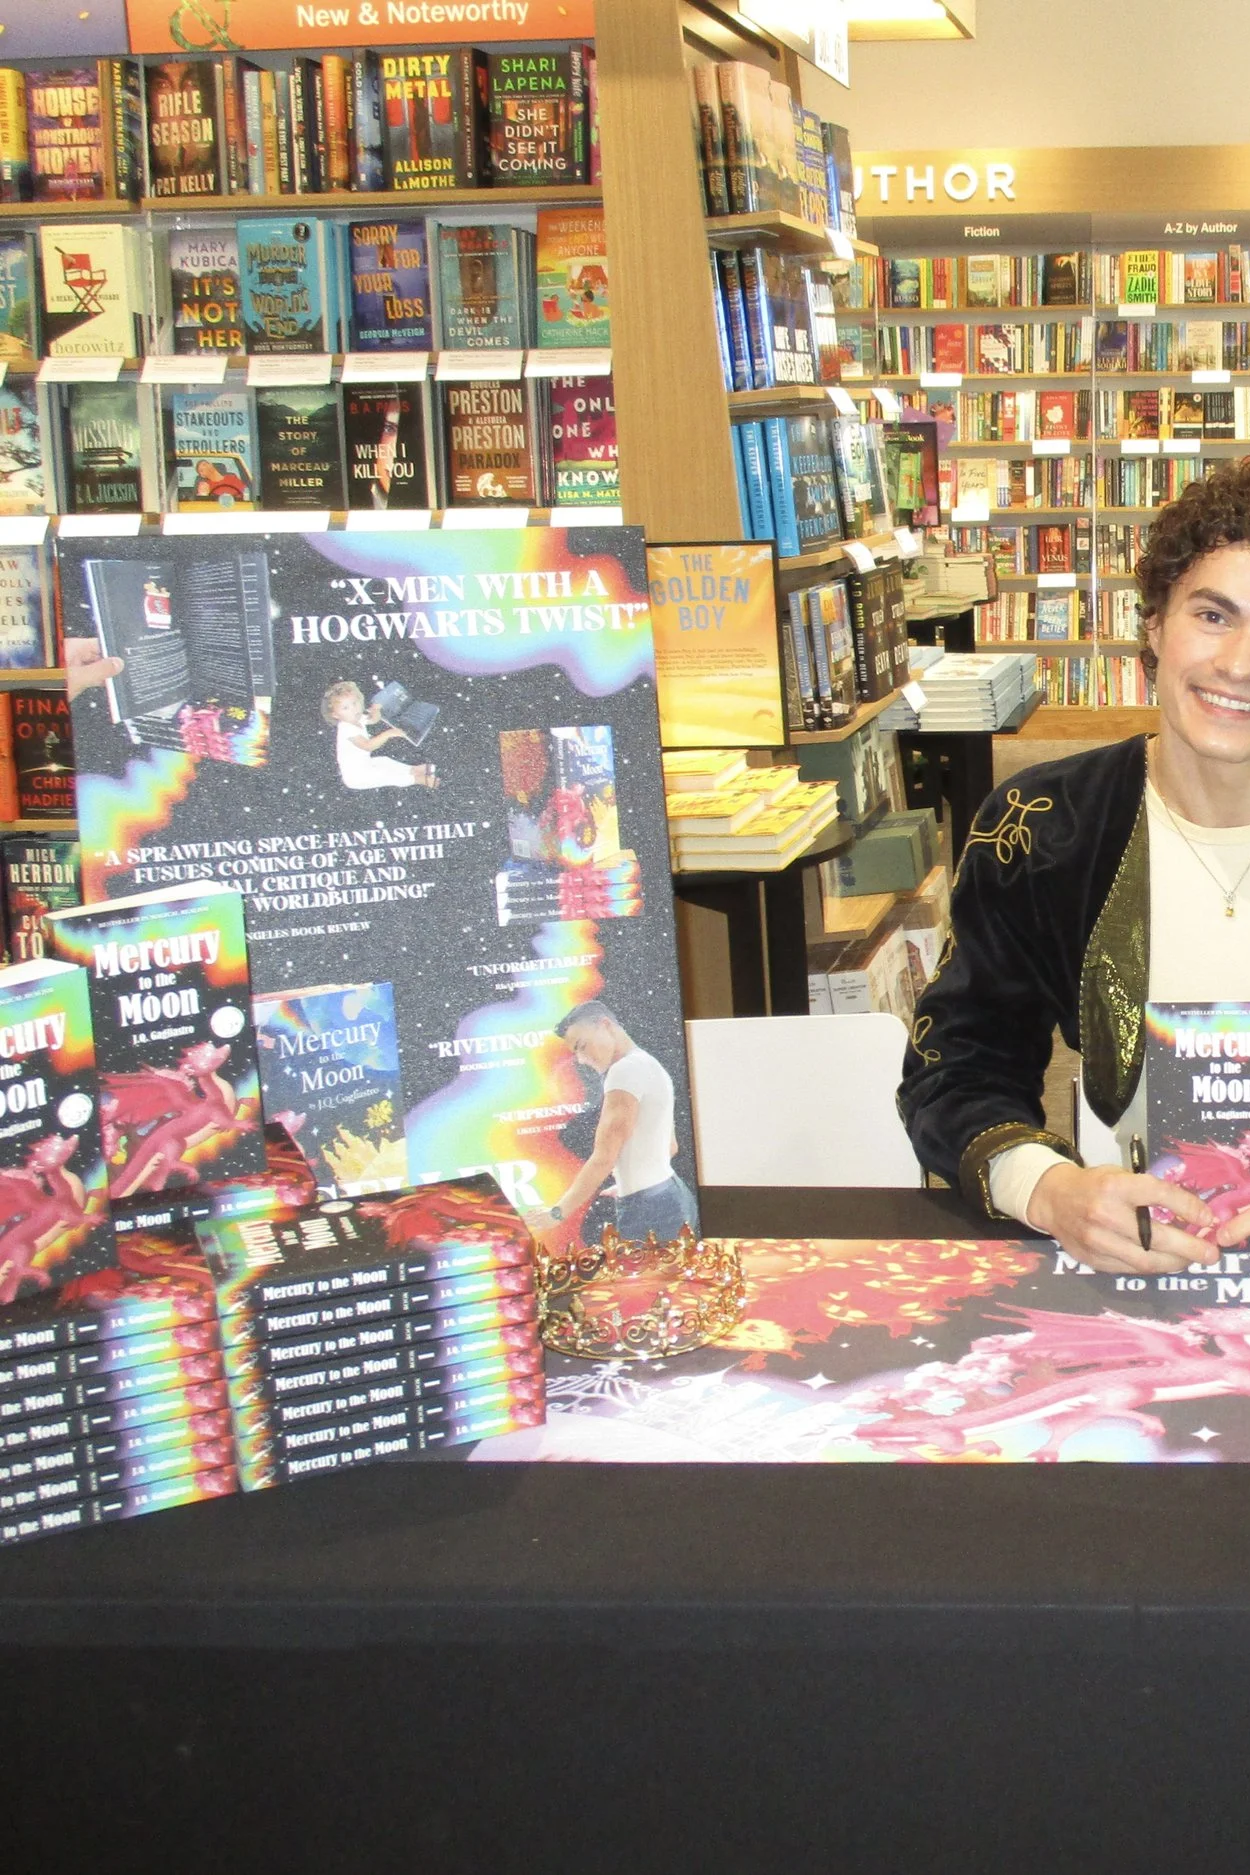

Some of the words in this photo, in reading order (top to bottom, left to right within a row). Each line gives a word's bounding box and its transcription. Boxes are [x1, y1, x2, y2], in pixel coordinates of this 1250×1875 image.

[296, 4, 349, 28] New
[358, 2, 379, 25] &
[387, 0, 529, 25] Noteworthy
[383, 54, 450, 78] DIRTY
[501, 58, 556, 73] SHARI
[355, 62, 363, 88] COLD
[494, 77, 567, 91] LAPENA
[385, 80, 452, 100] METAL
[32, 86, 99, 118] HOUSE
[158, 90, 202, 117] RIFLE
[517, 108, 548, 121] SHE
[114, 109, 125, 153] WEEKEND
[152, 117, 214, 147] SEASON
[505, 124, 560, 138] DIDN'T
[508, 141, 537, 155] SEE
[541, 141, 558, 154] IT
[395, 157, 453, 173] ALLISON
[499, 158, 567, 172] COMING
[156, 177, 176, 195] PAT
[180, 173, 215, 193] KELLY
[853, 163, 1016, 203] THOR
[353, 225, 398, 246] SORRY
[963, 225, 1000, 237] Fiction
[1164, 223, 1184, 235] A-Z
[1186, 223, 1198, 236] by
[1200, 221, 1238, 234] Author
[188, 241, 226, 253] MARY
[180, 255, 237, 267] KUBICA
[393, 249, 421, 269] FOR
[1127, 264, 1157, 273] FRAUD
[191, 277, 236, 296] IT'S
[354, 273, 393, 293] YOUR
[1128, 277, 1157, 293] ZADIE
[1127, 293, 1157, 303] SMITH
[181, 303, 239, 323] NOT
[386, 297, 424, 319] LOSS
[450, 307, 477, 316] DARK
[482, 307, 491, 315] IS
[456, 317, 488, 325] WHEN
[493, 316, 514, 324] THE
[197, 330, 243, 348] HER
[449, 327, 483, 336] DEVIL
[467, 337, 510, 347] COMES
[450, 389, 523, 416] PRESTON
[574, 398, 615, 412] ONL
[176, 411, 244, 427] STAKEOUTS
[285, 416, 309, 425] THE
[278, 431, 318, 441] STORY
[452, 424, 525, 450] PRESTON
[552, 422, 591, 439] ONE
[178, 439, 246, 454] STROLLERS
[291, 446, 307, 456] OF
[355, 443, 398, 459] WHEN
[589, 446, 618, 460] WH
[271, 462, 330, 472] MARCEAU
[459, 452, 521, 469] PARADOX
[354, 462, 379, 479] KILL
[386, 462, 415, 479] YOU
[558, 468, 619, 487] KNOW
[279, 477, 324, 488] MILLER
[558, 491, 580, 499] LISA
[679, 554, 713, 573] THE
[473, 573, 569, 601] WITH
[583, 570, 609, 597] A
[651, 575, 750, 607] GOLDEN
[291, 607, 506, 645] HOGWARTS
[678, 606, 727, 632] BOY
[15, 699, 69, 714] FINA
[33, 776, 76, 790] CHRIS
[127, 839, 254, 865] SPRAWLING
[257, 826, 421, 857] SPACE-FANTASY
[423, 821, 477, 842] THAT
[25, 849, 57, 863] MICK
[134, 862, 214, 885] FUSUES
[217, 849, 388, 880] COMING-OF-AGE
[390, 843, 445, 863] WITH
[10, 864, 75, 884] HERRON
[262, 869, 364, 894] CRITIQUE
[365, 865, 407, 885] AND
[247, 923, 288, 942] NGELES
[290, 922, 326, 938] BOOK
[327, 919, 371, 935] REVIEW
[93, 928, 220, 979] Mercury
[138, 975, 152, 990] to
[155, 972, 177, 988] the
[118, 986, 200, 1027] Moon
[0, 1011, 66, 1059] cury
[150, 1024, 195, 1041] Gagliastro
[277, 1019, 382, 1060] Mercury
[318, 1053, 332, 1064] to
[332, 1049, 346, 1063] the
[1209, 1062, 1222, 1074] to
[1223, 1061, 1242, 1074] the
[301, 1064, 366, 1094] Moon
[1201, 1110, 1215, 1121] J.Q.
[114, 1219, 133, 1232] the
[136, 1212, 171, 1229] Moon
[263, 1281, 315, 1302] Mercury
[317, 1280, 329, 1292] to
[331, 1276, 350, 1289] the
[352, 1269, 388, 1286] Moon
[1115, 1277, 1146, 1291] to
[1157, 1273, 1209, 1291] the
[288, 1453, 338, 1475] Mercury
[341, 1451, 352, 1463] to
[354, 1447, 371, 1460] the
[374, 1437, 408, 1456] Moon
